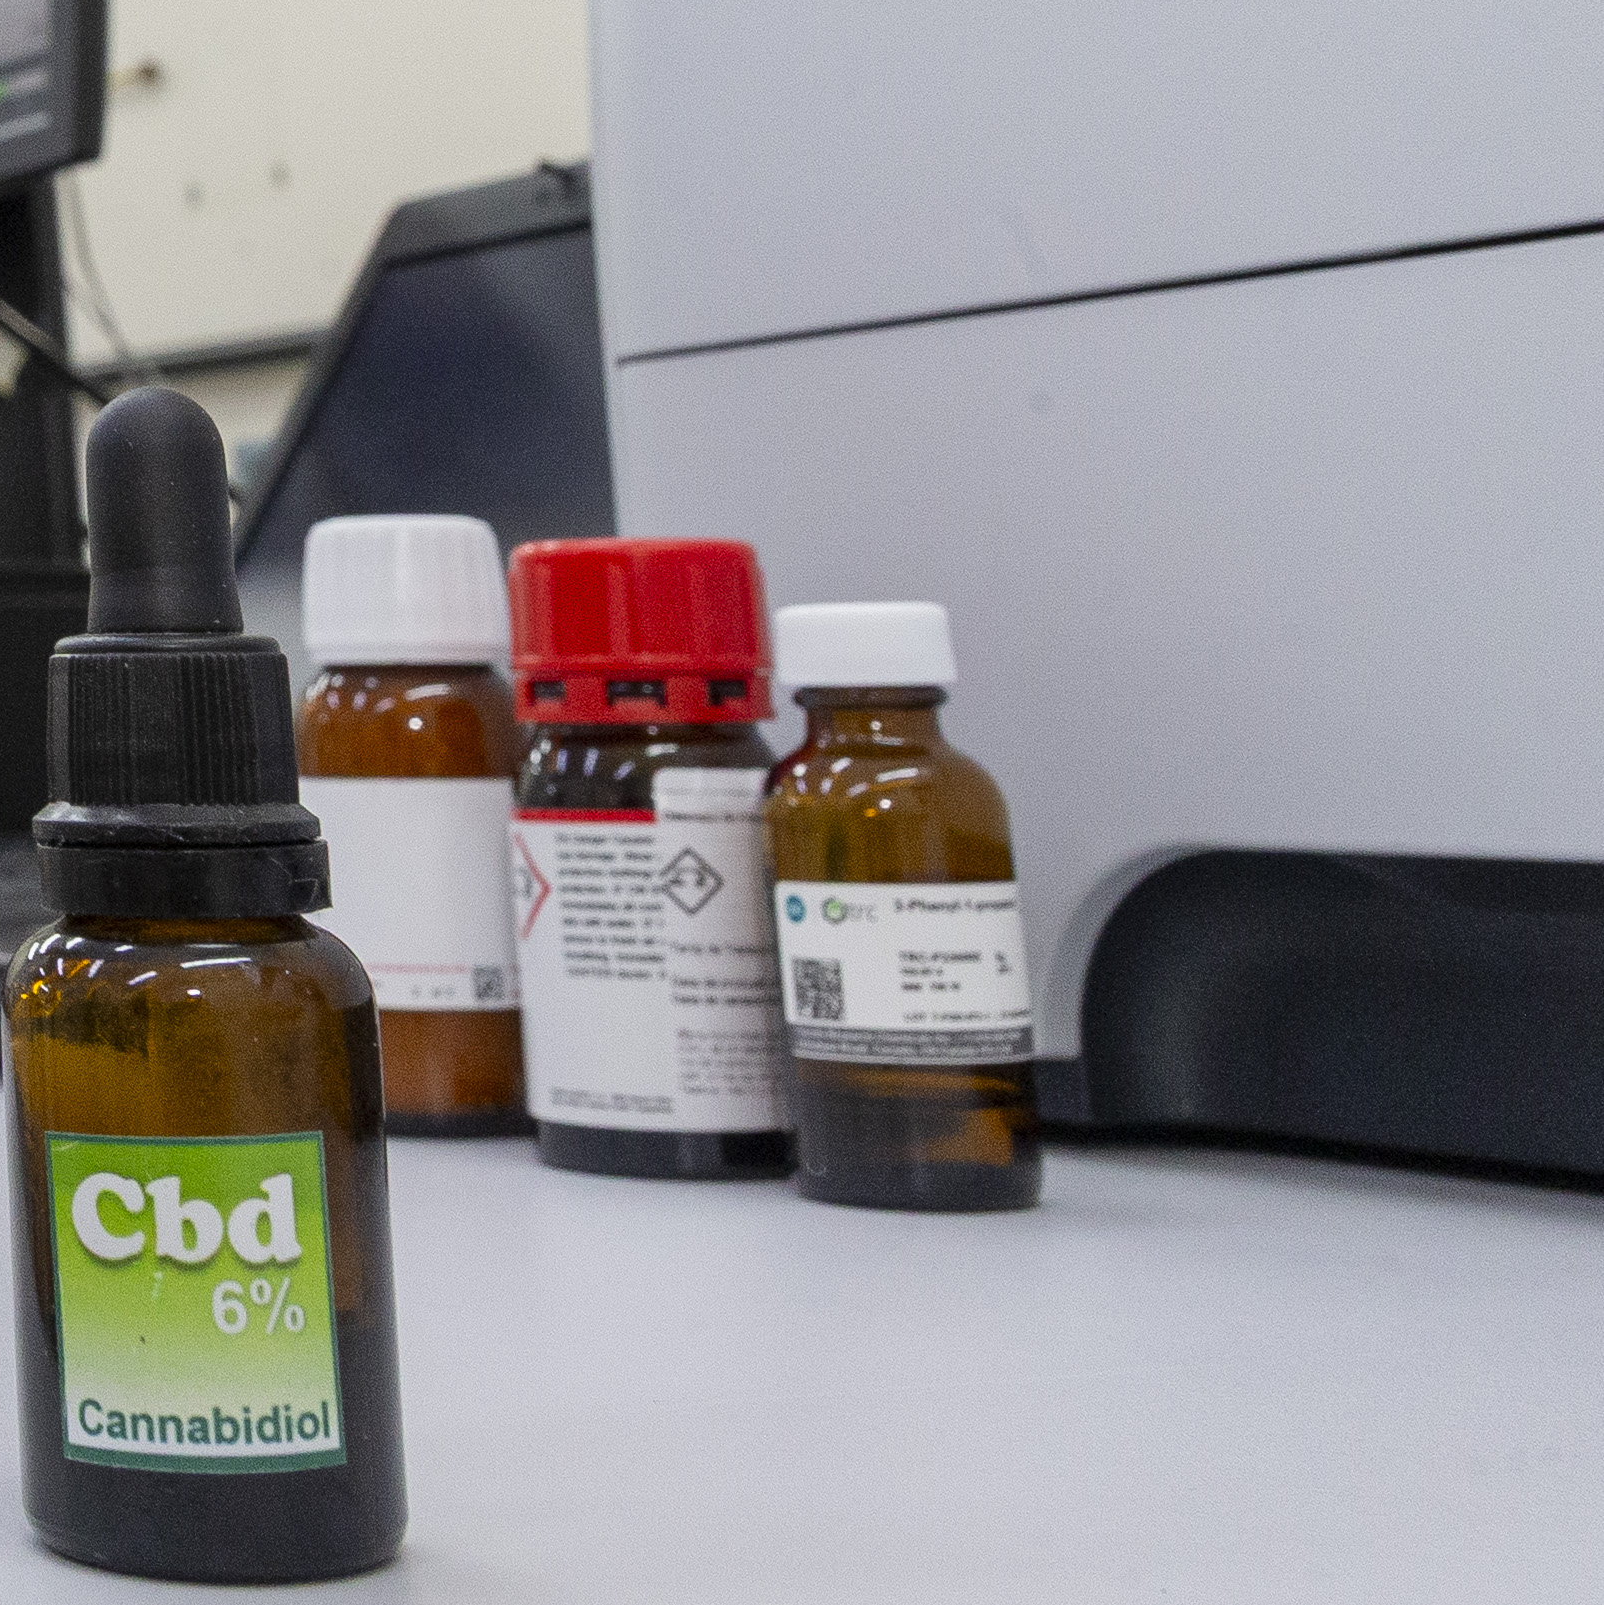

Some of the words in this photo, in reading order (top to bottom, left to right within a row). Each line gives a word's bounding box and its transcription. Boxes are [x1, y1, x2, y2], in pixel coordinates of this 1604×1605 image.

[71, 1171, 303, 1265] Cbd
[211, 1277, 306, 1336] 6%
[77, 1397, 332, 1445] Cannabidiol
